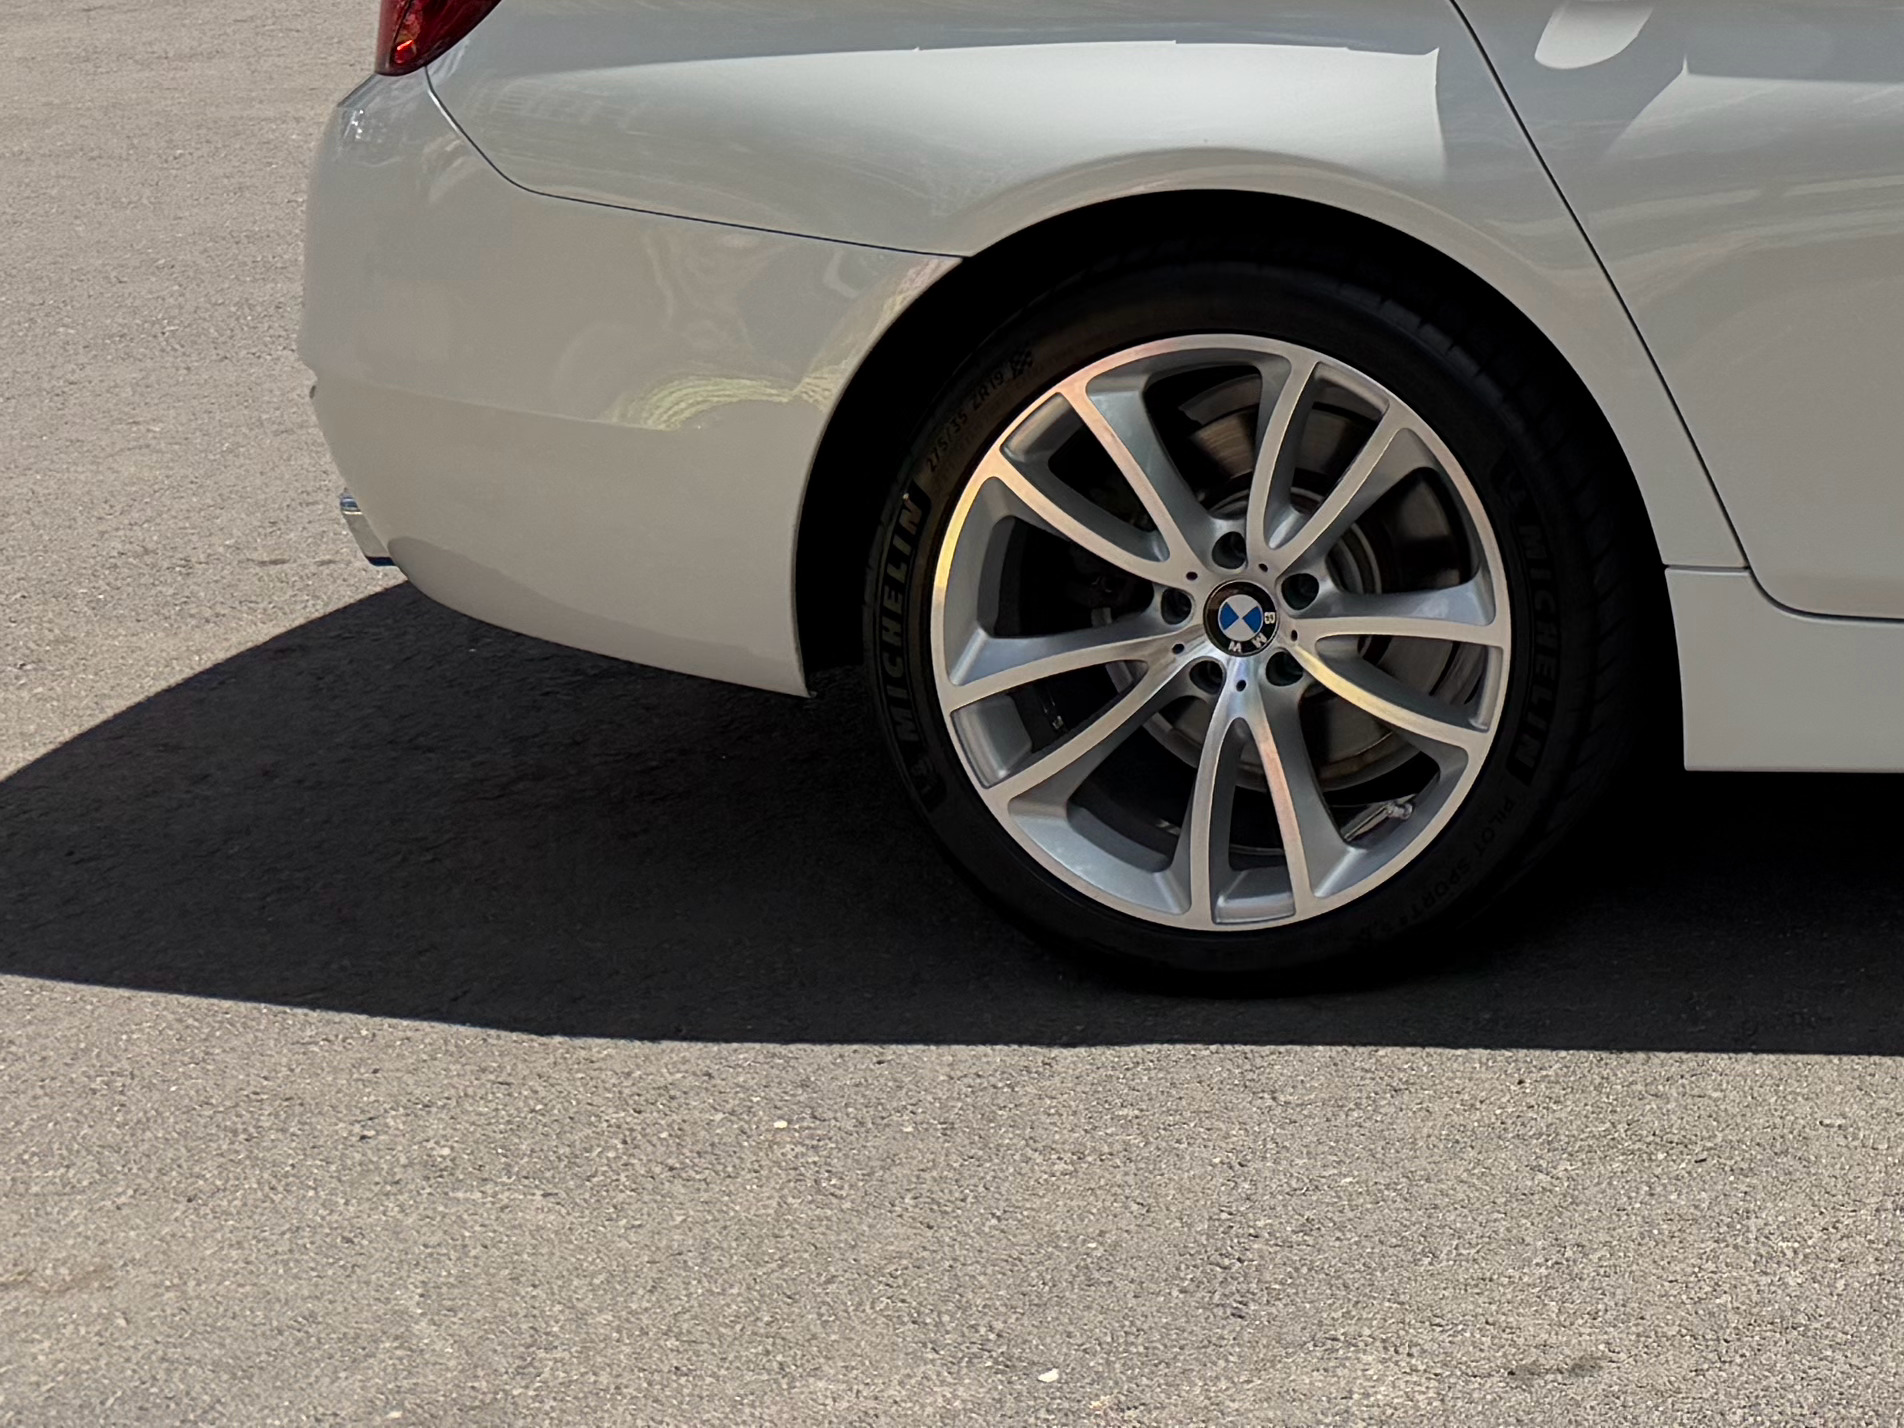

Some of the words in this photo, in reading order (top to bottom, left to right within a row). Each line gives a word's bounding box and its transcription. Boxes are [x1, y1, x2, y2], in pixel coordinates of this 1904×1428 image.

[970, 372, 1005, 411] ZR19
[880, 496, 925, 745] MICHELIN
[1514, 524, 1558, 771] MICHELIN
